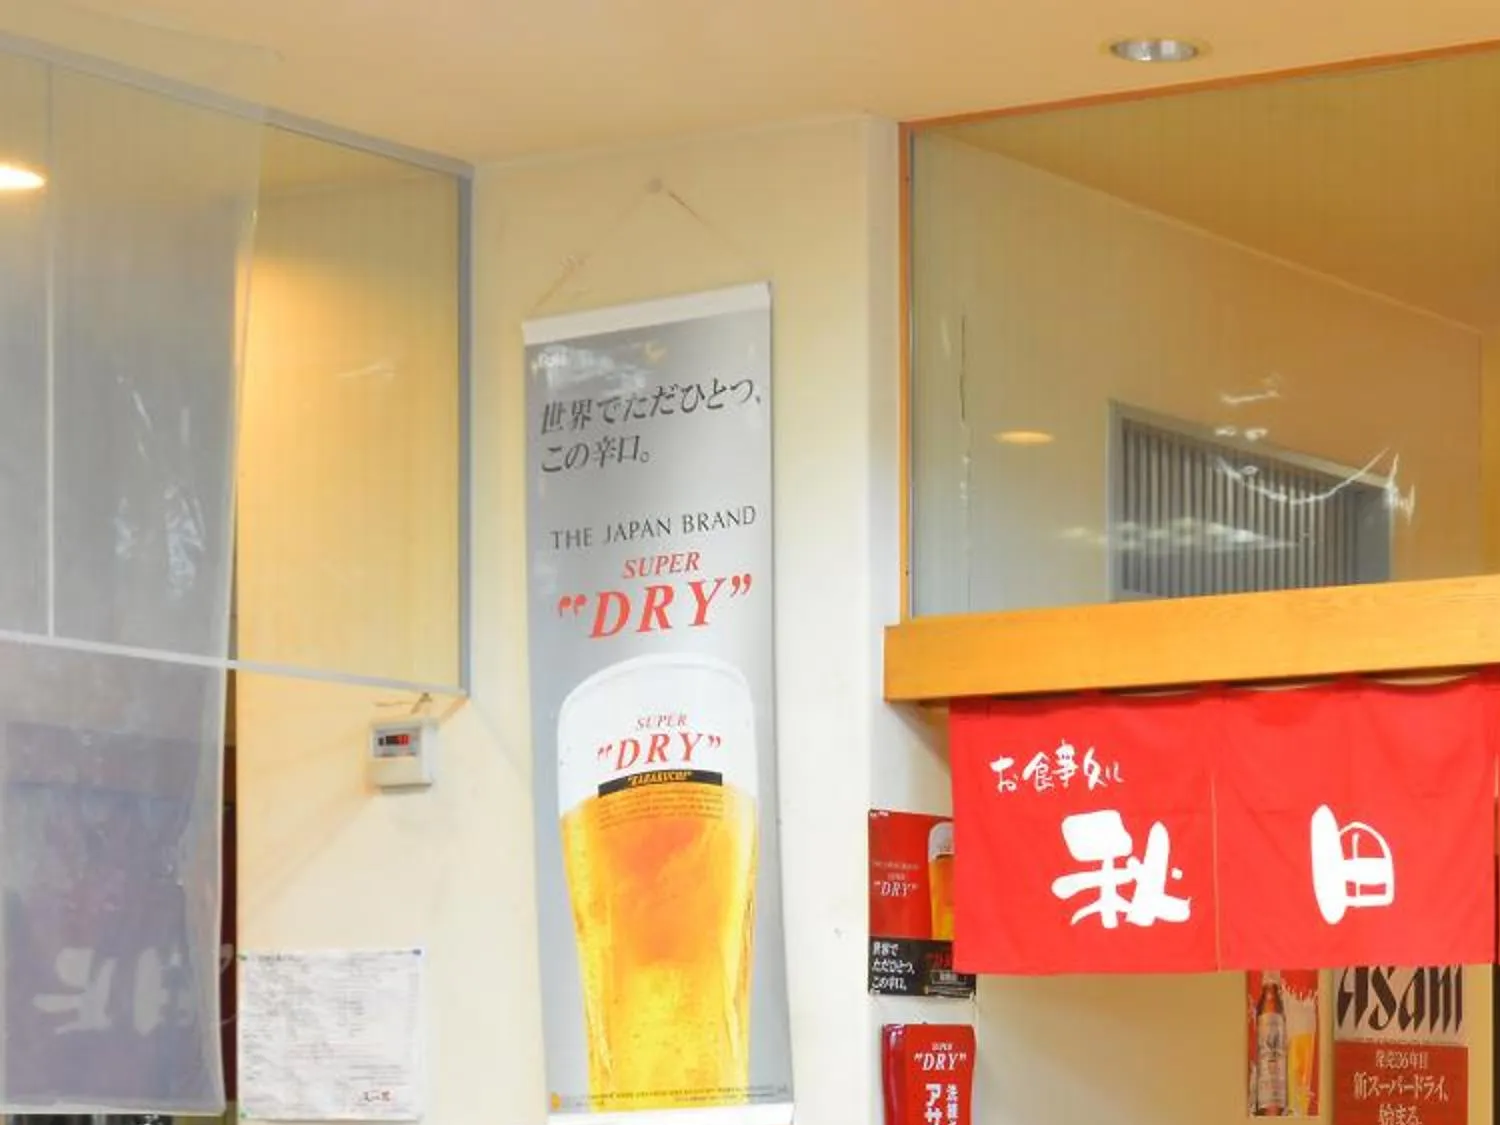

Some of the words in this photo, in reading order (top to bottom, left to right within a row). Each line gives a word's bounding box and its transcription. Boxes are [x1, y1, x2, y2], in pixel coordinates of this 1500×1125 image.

[541, 377, 762, 436] 世界でただひとつ、
[541, 435, 650, 473] この辛口。
[551, 527, 593, 551] THE
[604, 516, 672, 544] JAPAN
[682, 505, 758, 535] BRAND
[622, 551, 701, 579] SUPER
